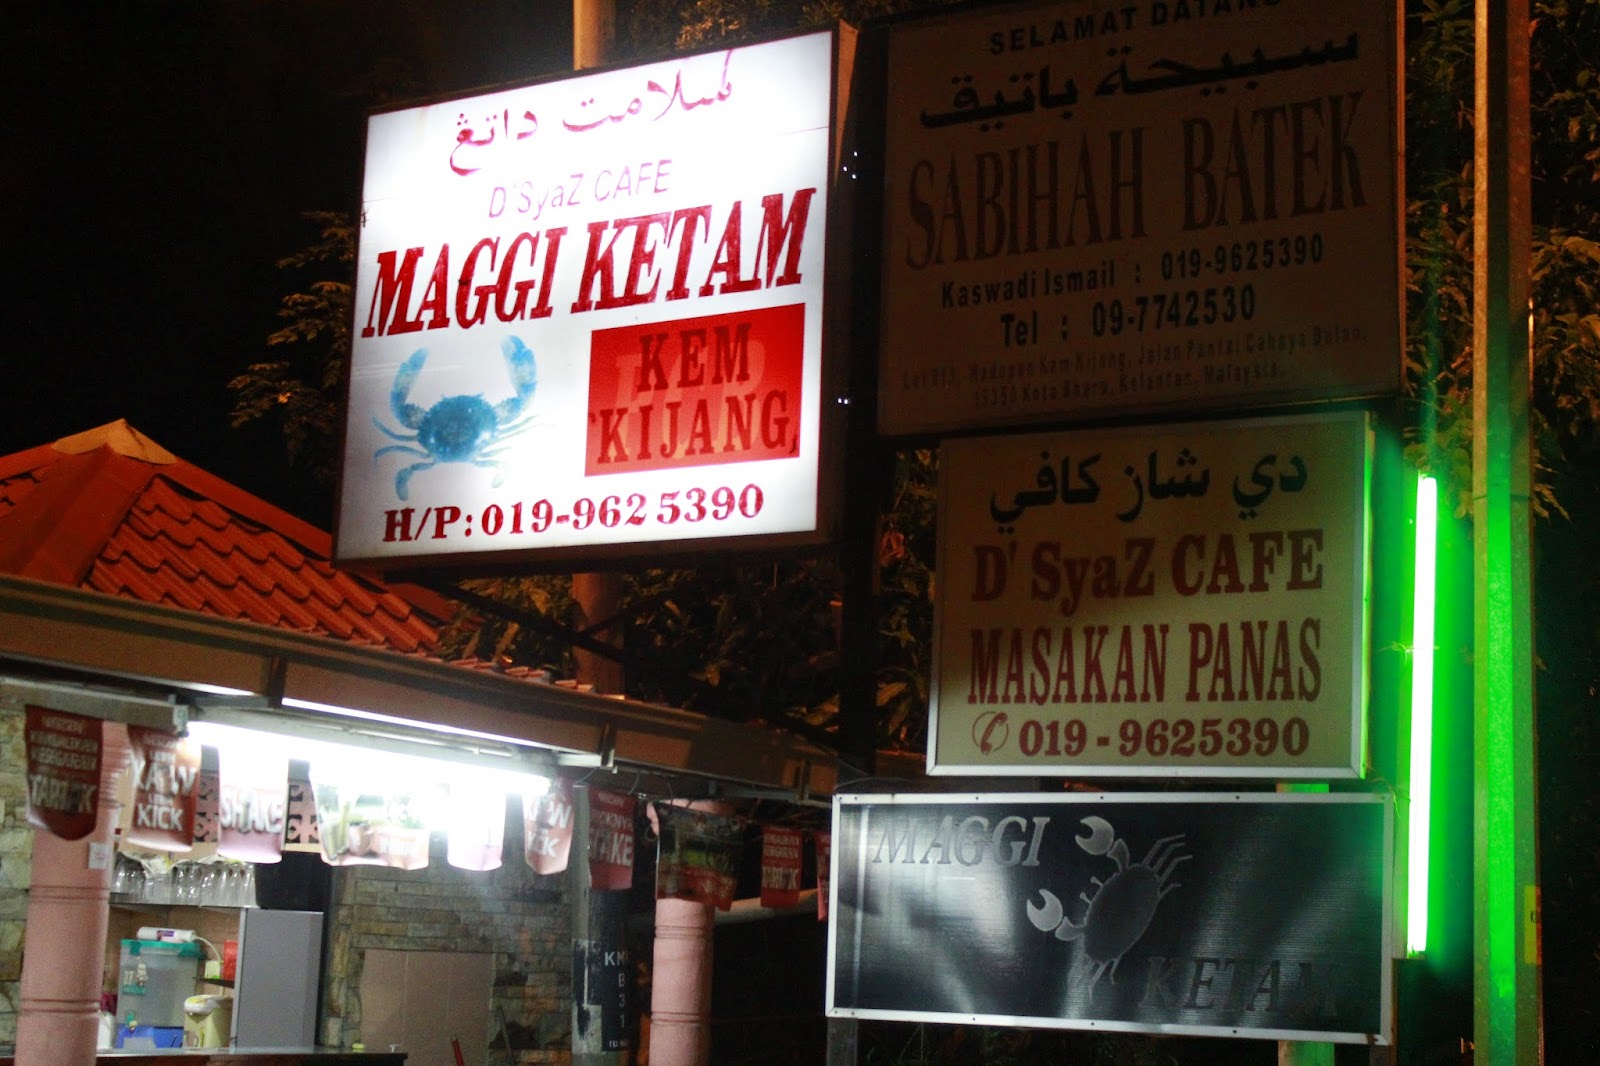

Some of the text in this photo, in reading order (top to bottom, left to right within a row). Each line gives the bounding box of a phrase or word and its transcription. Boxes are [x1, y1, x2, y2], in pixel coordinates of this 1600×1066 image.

[989, 0, 1281, 55] SELAMAT DATA
[594, 159, 672, 202] CAFE
[905, 90, 1368, 271] SABIHAH BATEK
[362, 187, 817, 337] MAGGI KETAM
[940, 270, 1036, 309] Kaswadi
[1044, 260, 1116, 295] Ismail
[1161, 233, 1324, 280] 019-9625390
[1001, 310, 1038, 347] Tel
[1091, 283, 1256, 337] 09-7742530
[637, 322, 752, 392] KEM
[598, 388, 790, 465] KIJANG
[1171, 528, 1324, 597] CAFE
[967, 616, 1322, 706] MASAKAN PANAS
[137, 802, 184, 832] KICK
[872, 815, 1052, 868] MAGGI
[1137, 956, 1339, 1017] KETAM
